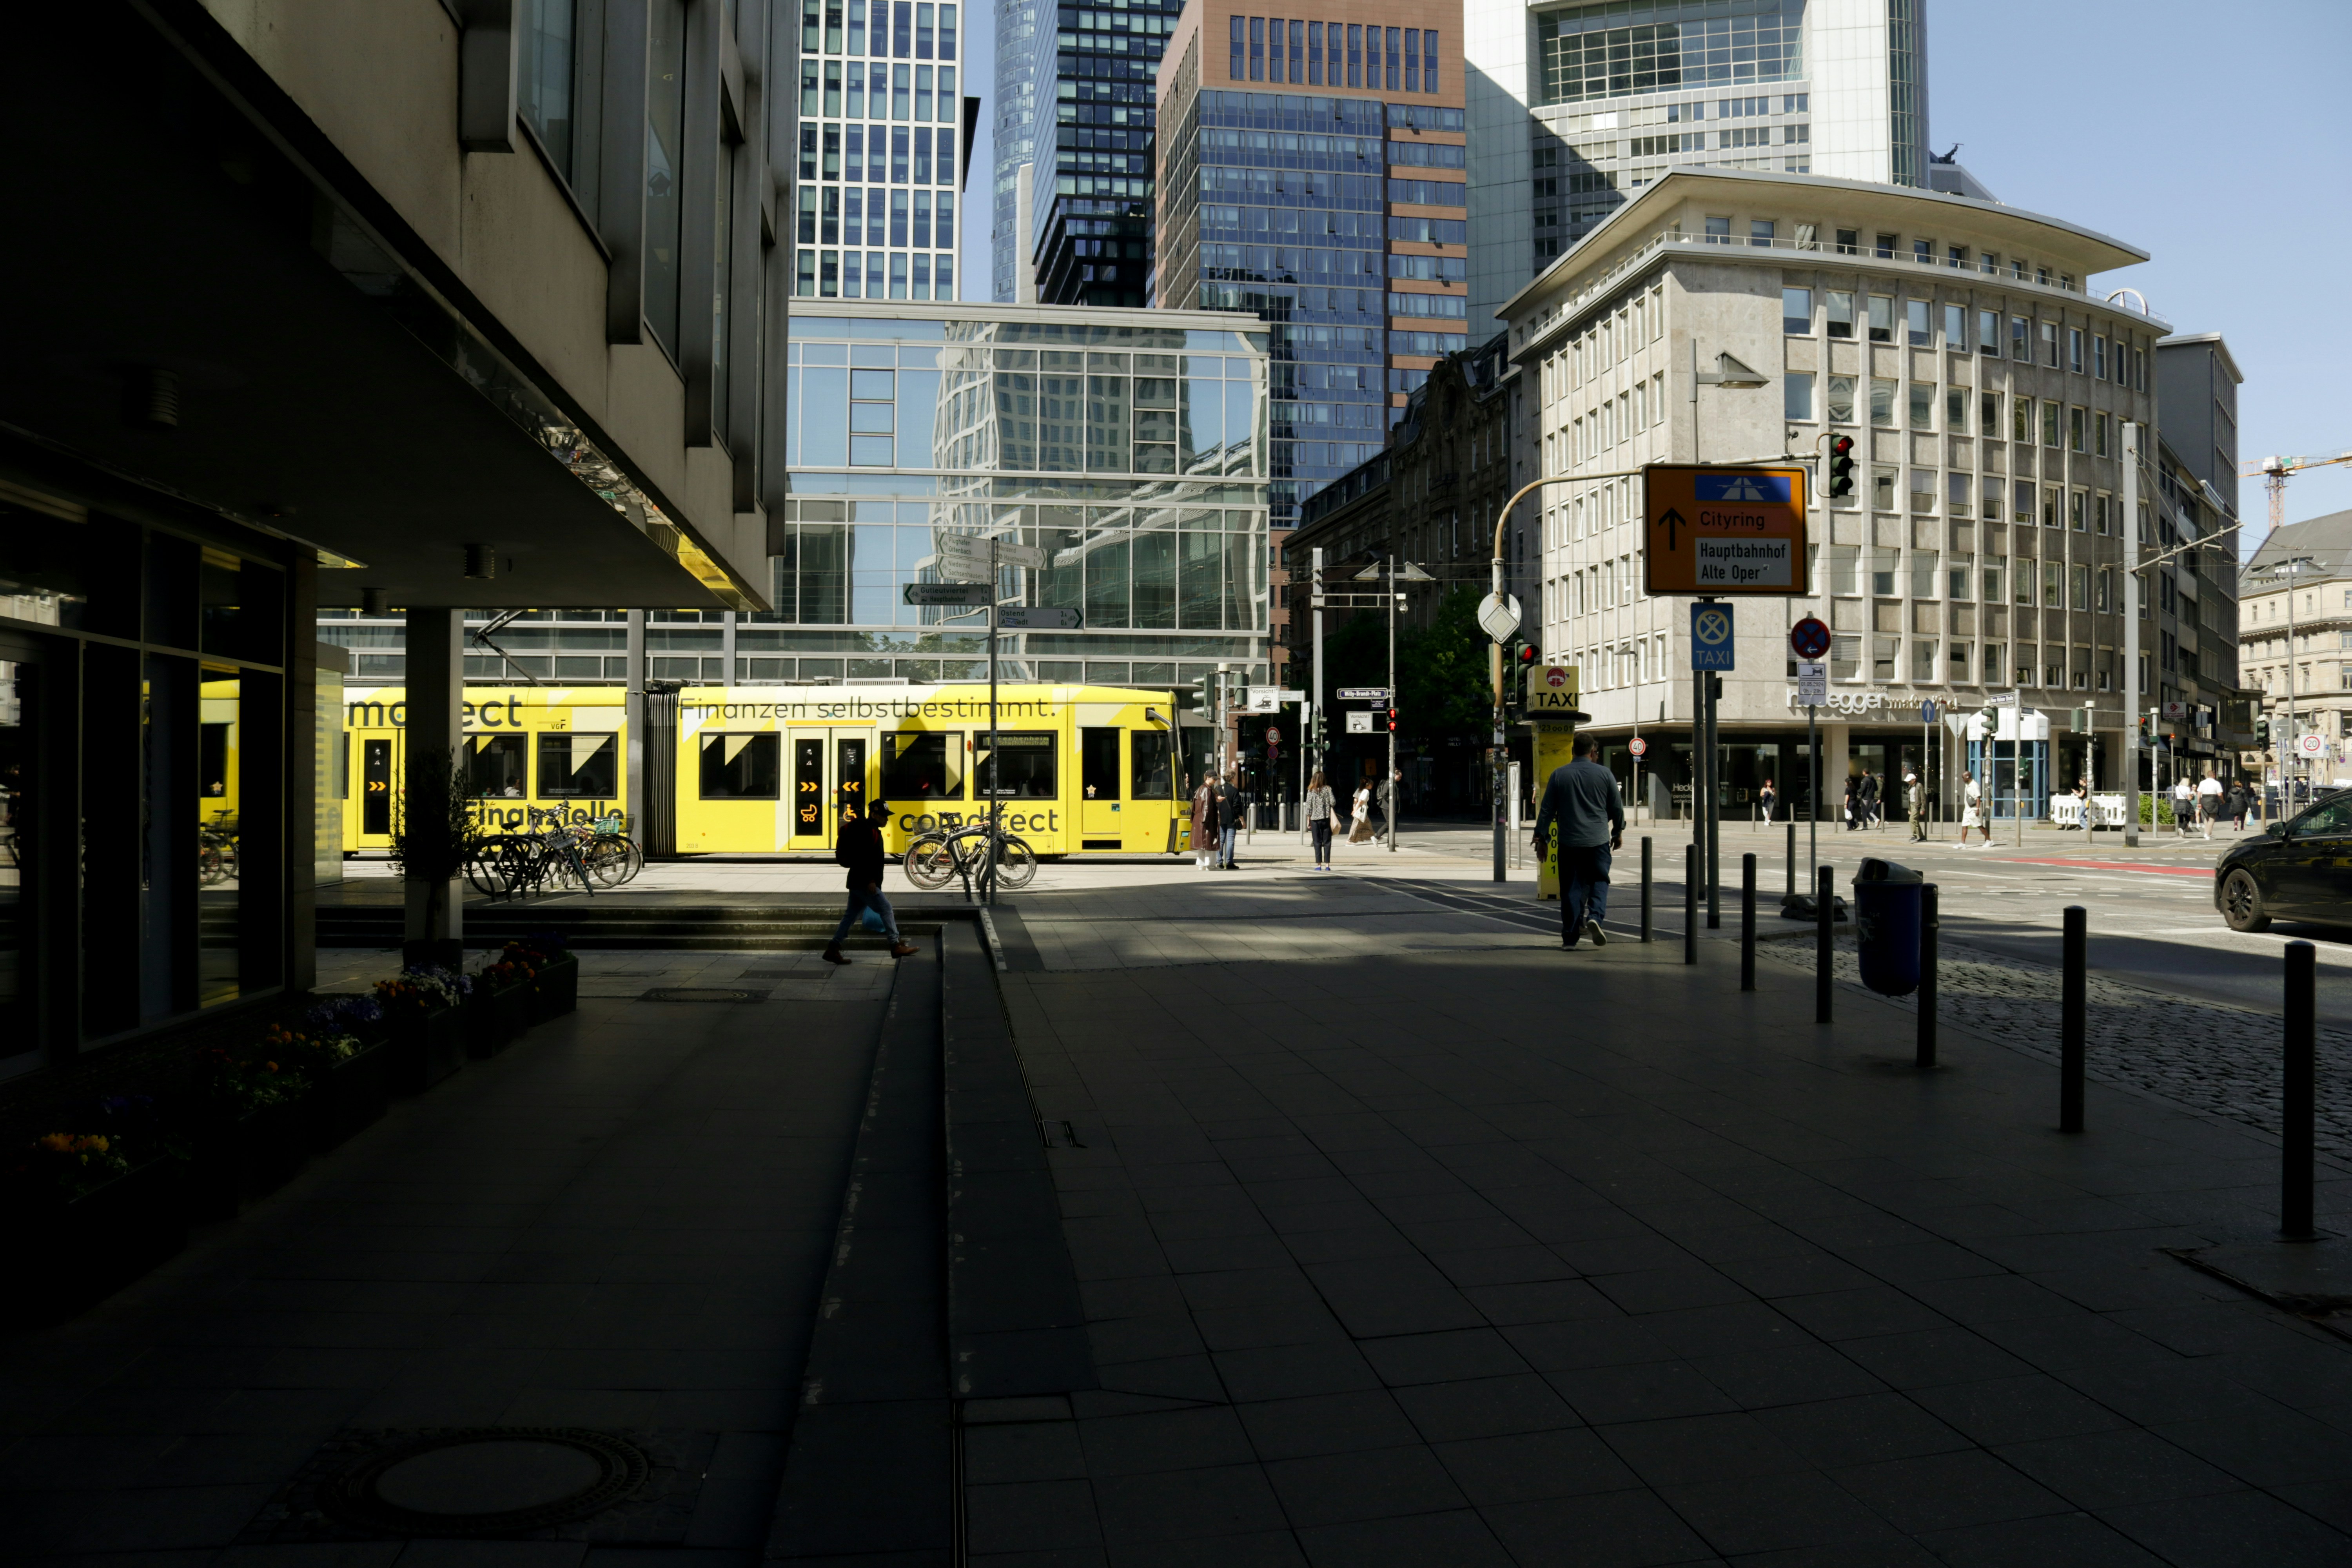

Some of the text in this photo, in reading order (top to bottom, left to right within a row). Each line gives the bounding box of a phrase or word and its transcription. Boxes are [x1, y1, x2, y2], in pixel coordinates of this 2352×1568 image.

[1700, 511, 1764, 530] Cityring
[949, 537, 971, 546] Flughafen
[949, 546, 971, 555] Offenbach
[1700, 543, 1786, 561] Hauptbahnhof
[948, 561, 971, 569] Niederrad
[1004, 554, 1029, 564] Hauptwache
[948, 570, 983, 579] Sachsenhausen
[1701, 564, 1760, 583] Alte Oper
[1696, 651, 1730, 664] TAXI
[1536, 693, 1578, 707] TAXI
[1787, 688, 1888, 714] hegger
[680, 696, 1055, 719] Finanzen selbstbestimmt.
[551, 719, 566, 729] VGF
